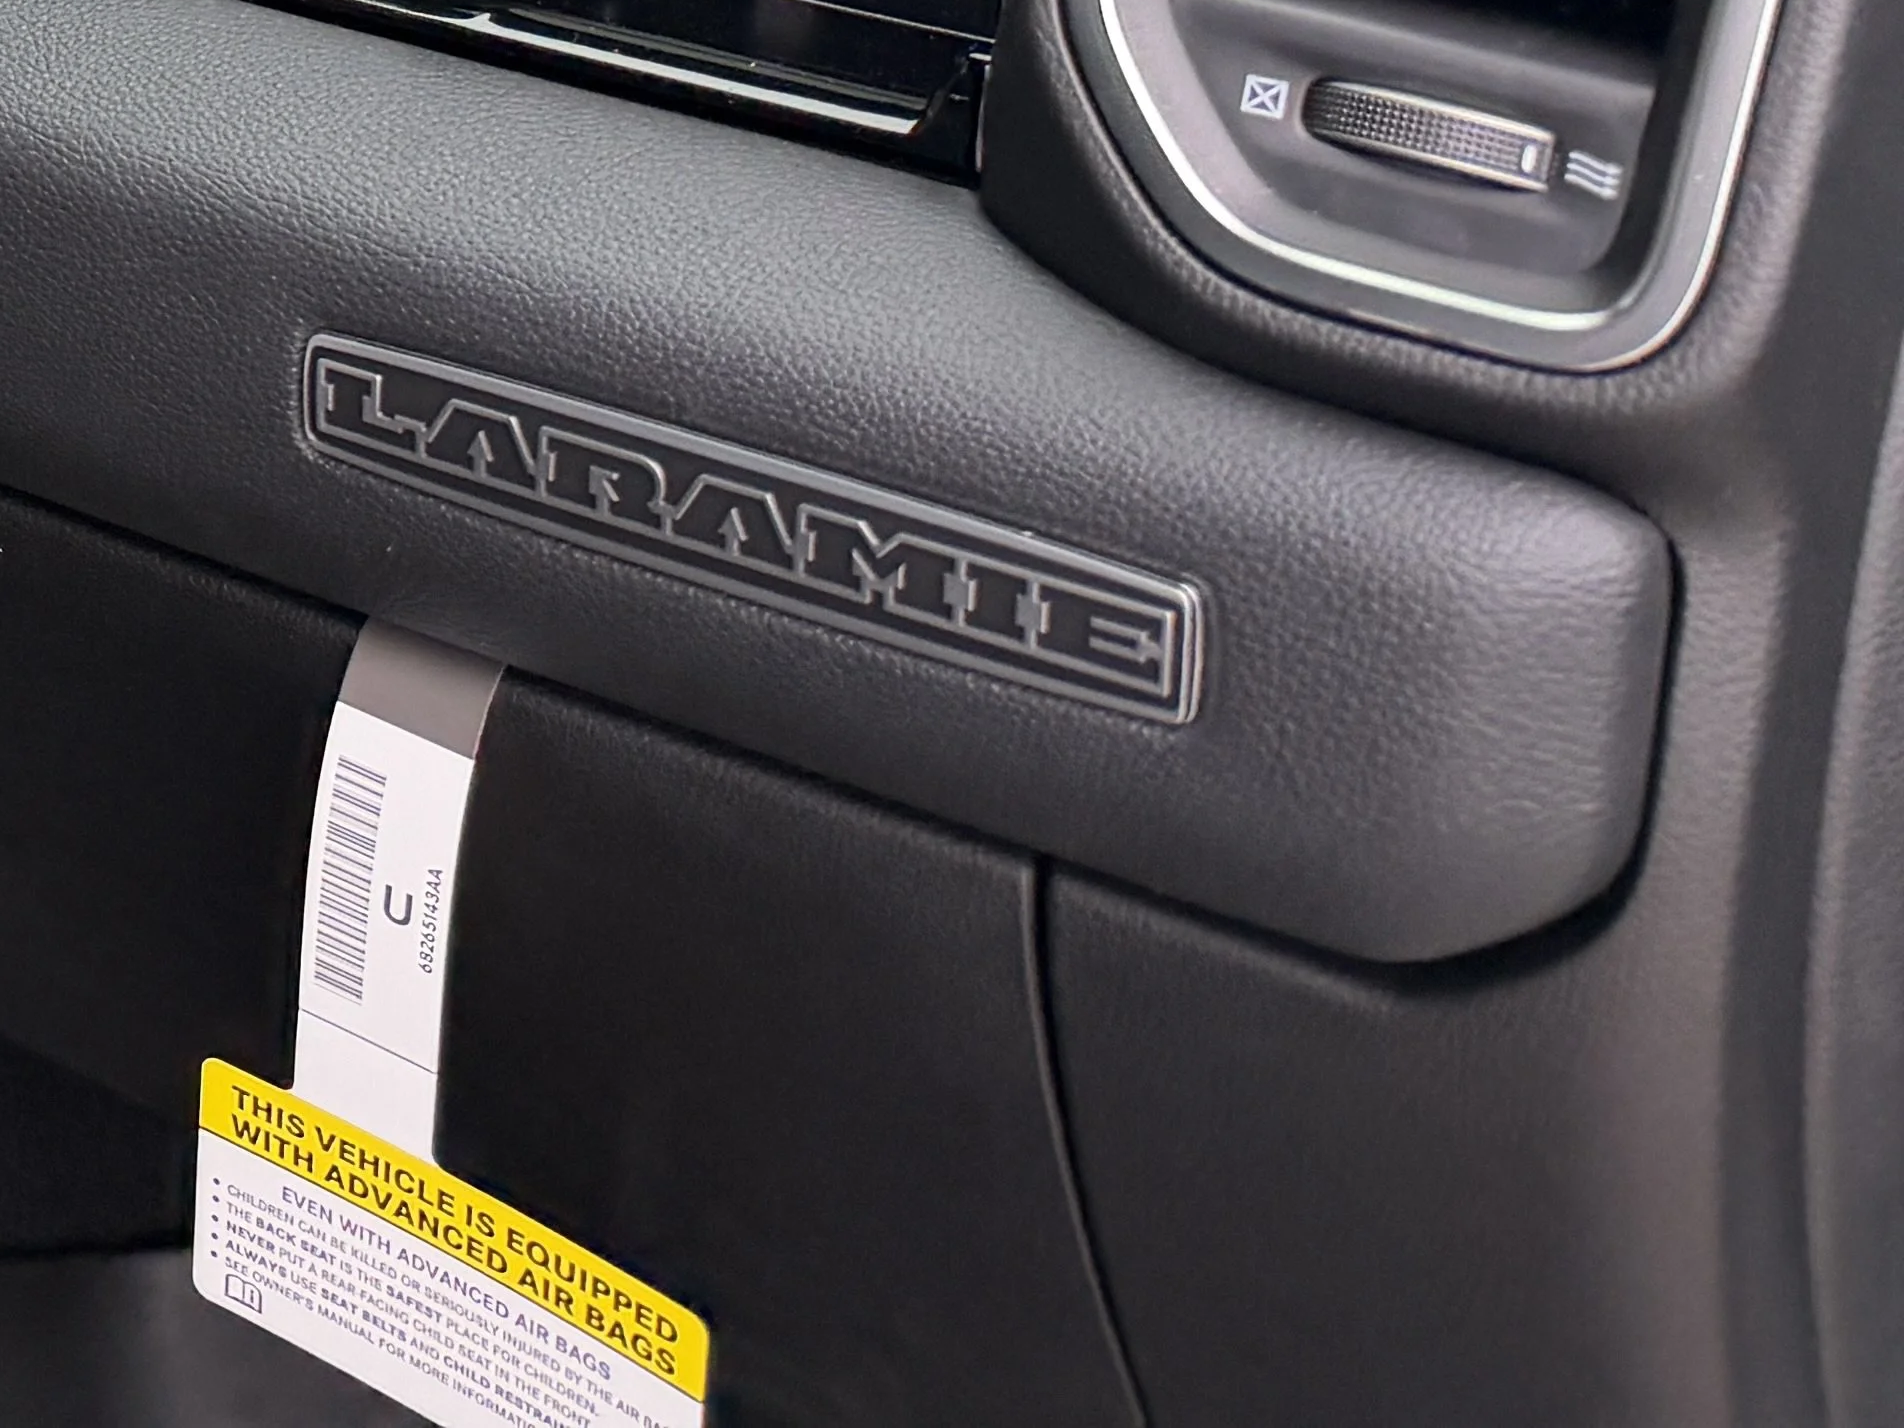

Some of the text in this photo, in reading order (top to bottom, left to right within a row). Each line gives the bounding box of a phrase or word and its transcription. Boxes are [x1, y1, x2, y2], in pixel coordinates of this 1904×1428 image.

[319, 364, 1174, 696] LARAMIE
[383, 884, 413, 926] U
[225, 1239, 287, 1278] ALWAYS
[291, 1270, 317, 1295] USE
[321, 1287, 358, 1315] SEAT
[362, 1309, 407, 1342] BELTS
[410, 1337, 440, 1361] AND
[443, 1355, 491, 1390] CHILD
[227, 1184, 640, 1421] CHILDREN CAN BE KILLED OR SERIOUSLY INJURED BY THE AIR
[227, 1201, 599, 1417] THE BACK SEAT IS THE SAFEST PLACE FOR CHILDREN.
[231, 1113, 676, 1375] WITH ADVANCED AIR BAGS
[232, 1085, 678, 1344] THIS VEHICLE IS EQUIPPED
[282, 1186, 611, 1381] EVEN WITH ADVANCED AIR BAGS
[225, 1256, 249, 1276] SEE
[252, 1270, 314, 1311] OWNER'S
[318, 1304, 374, 1345] MANUAL
[378, 1337, 406, 1362] FOR
[409, 1355, 450, 1387] MORE
[226, 1220, 275, 1253] NEVER
[279, 1247, 305, 1269] PUT
[308, 1262, 318, 1276] A
[413, 1318, 455, 1350] CHILD
[458, 1344, 492, 1371] SEAT
[495, 1364, 510, 1384] IN
[515, 1374, 540, 1400] THE
[543, 1393, 591, 1427] FRONT
